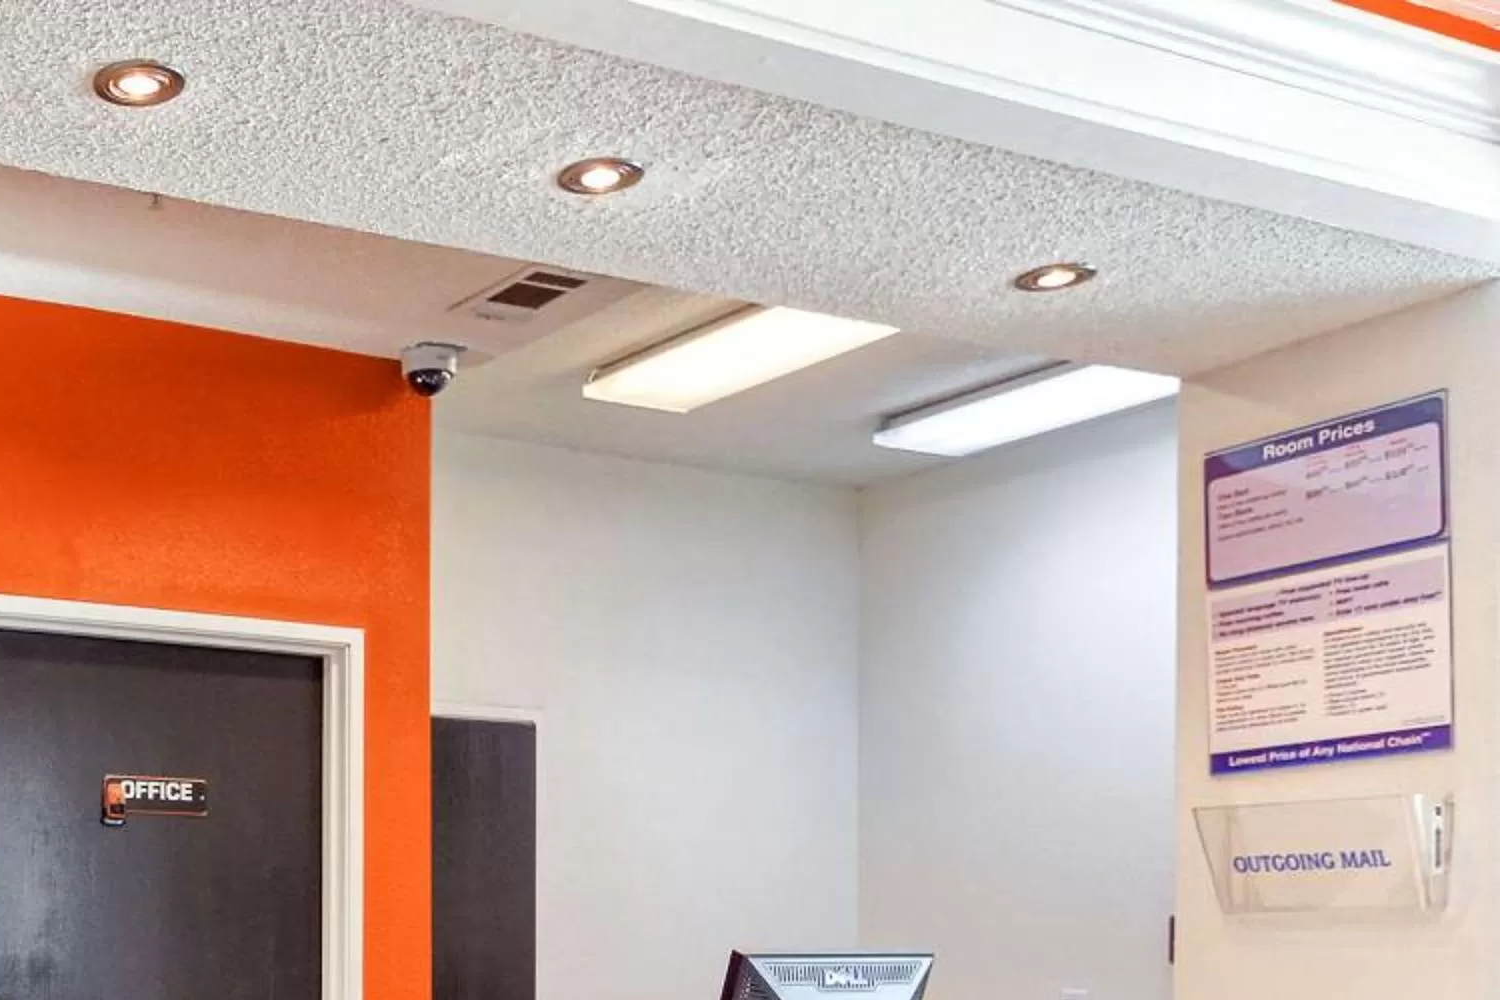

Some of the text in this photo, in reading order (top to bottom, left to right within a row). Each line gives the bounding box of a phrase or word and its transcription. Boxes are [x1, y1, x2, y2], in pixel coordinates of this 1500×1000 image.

[1263, 437, 1313, 461] Room
[1318, 420, 1375, 445] Prices
[1228, 753, 1267, 767] Lowest
[1269, 750, 1296, 765] Price
[1298, 748, 1311, 760] of
[1311, 746, 1335, 761] Any
[1337, 738, 1385, 754] National
[120, 779, 193, 801] OFFICE
[1233, 849, 1392, 874] OUTGOING MAIL
